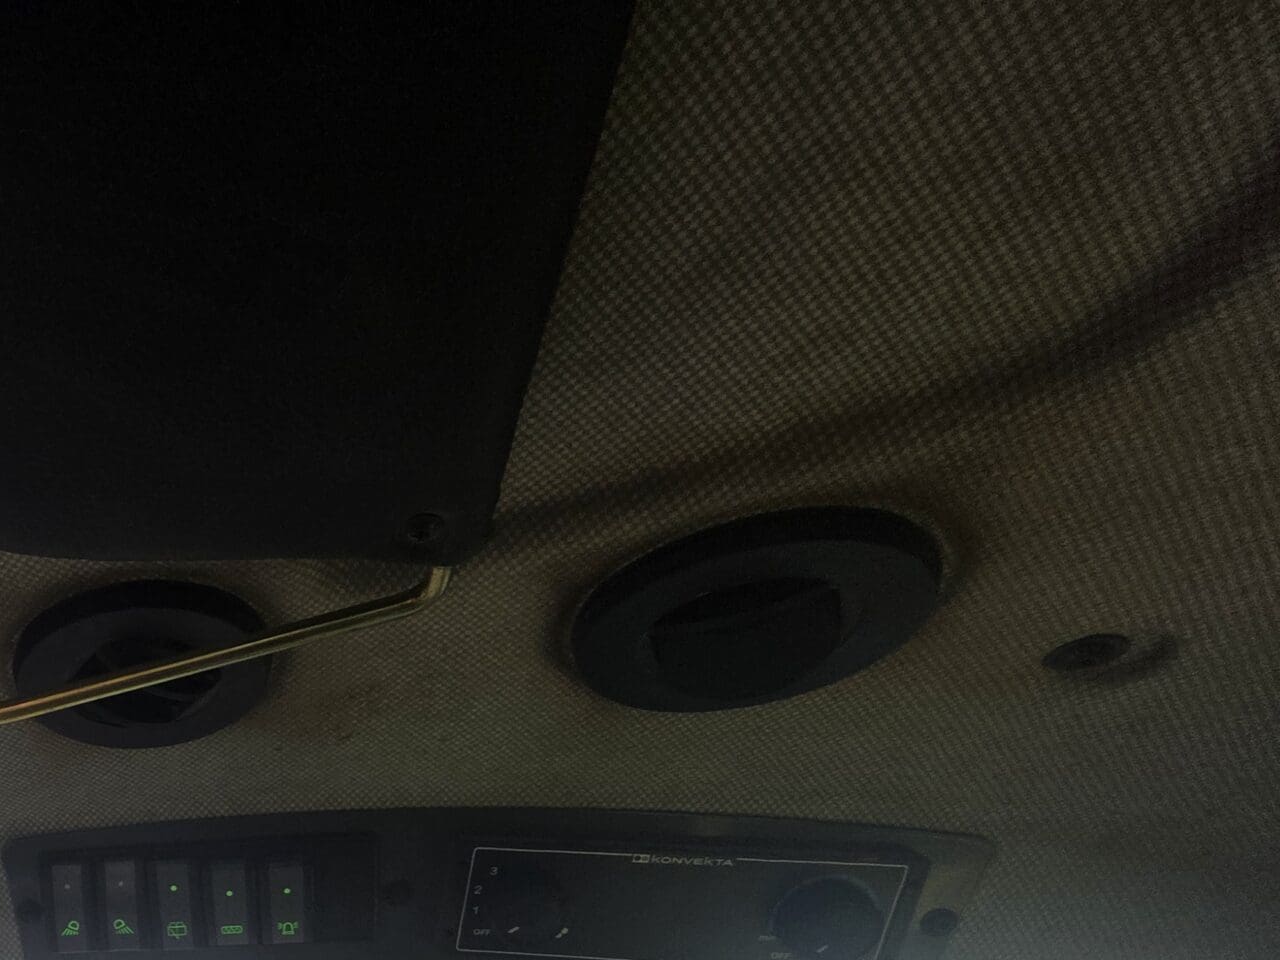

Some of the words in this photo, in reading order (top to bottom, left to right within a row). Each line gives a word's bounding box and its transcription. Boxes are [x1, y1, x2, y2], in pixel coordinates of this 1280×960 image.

[651, 854, 734, 867] KONVEKTA
[489, 866, 498, 876] 3
[473, 885, 482, 895] 2
[472, 906, 479, 915] 1
[473, 928, 491, 936] OFF
